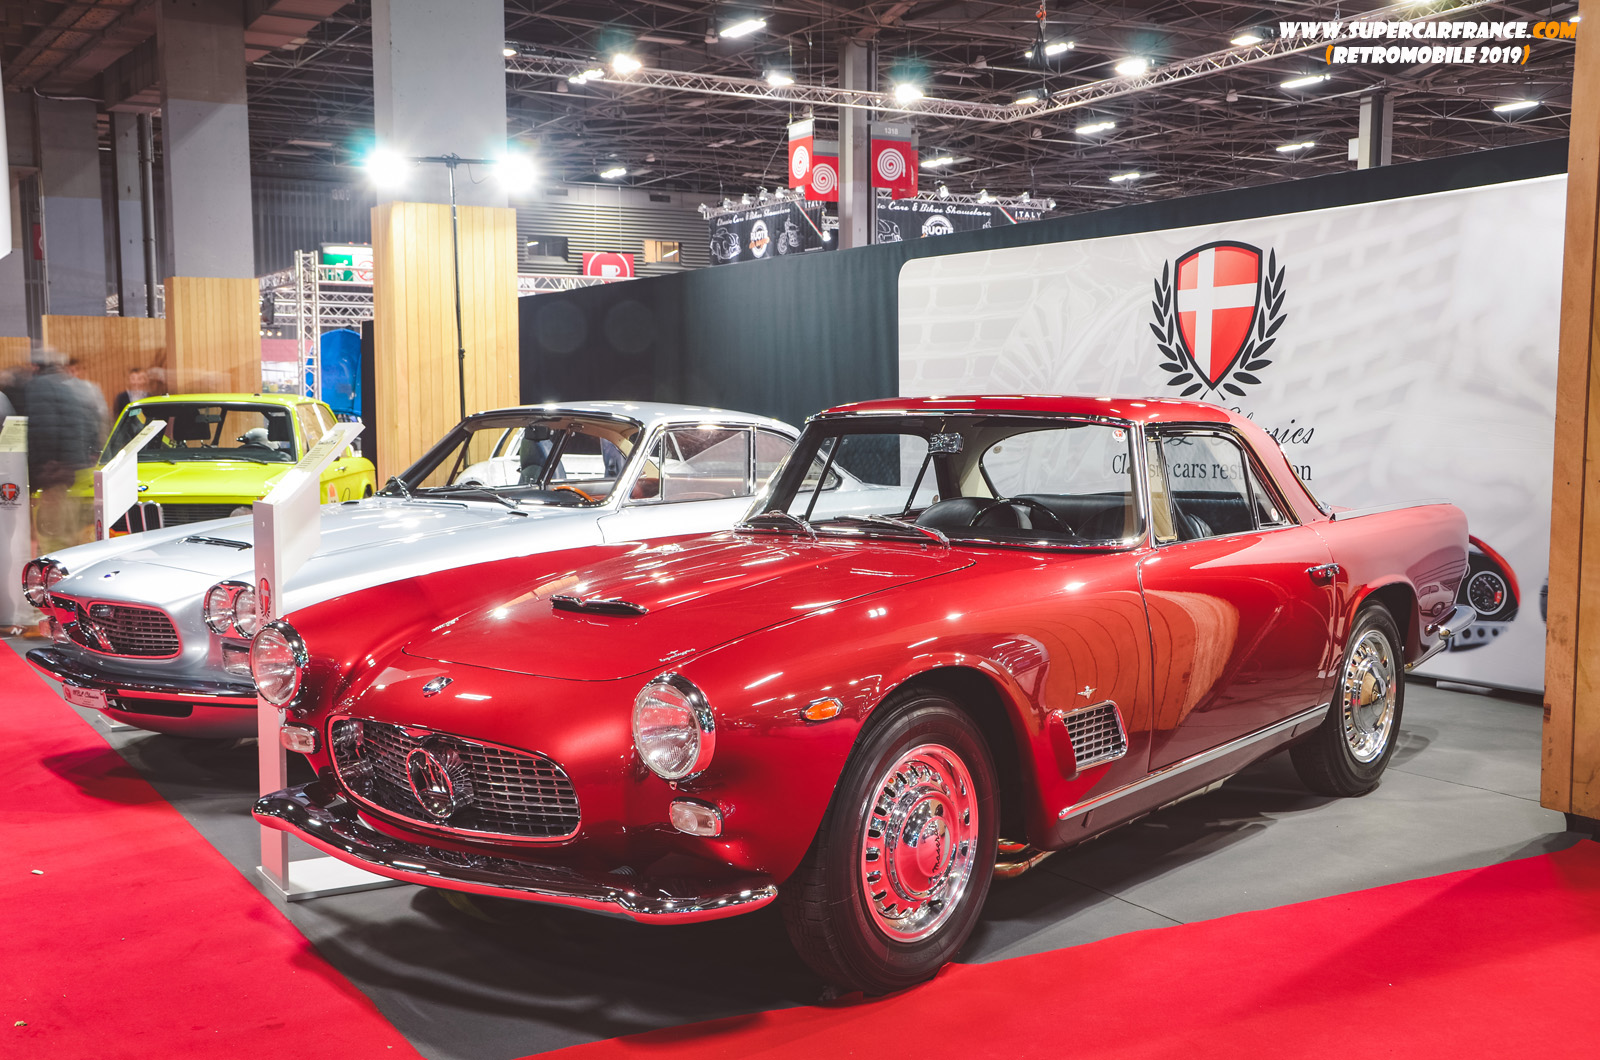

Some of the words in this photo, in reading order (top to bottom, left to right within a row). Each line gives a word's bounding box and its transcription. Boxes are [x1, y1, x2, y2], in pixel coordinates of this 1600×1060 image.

[1014, 210, 1042, 219] ITALY
[921, 225, 954, 238] RUOTE
[1173, 463, 1207, 478] cars
